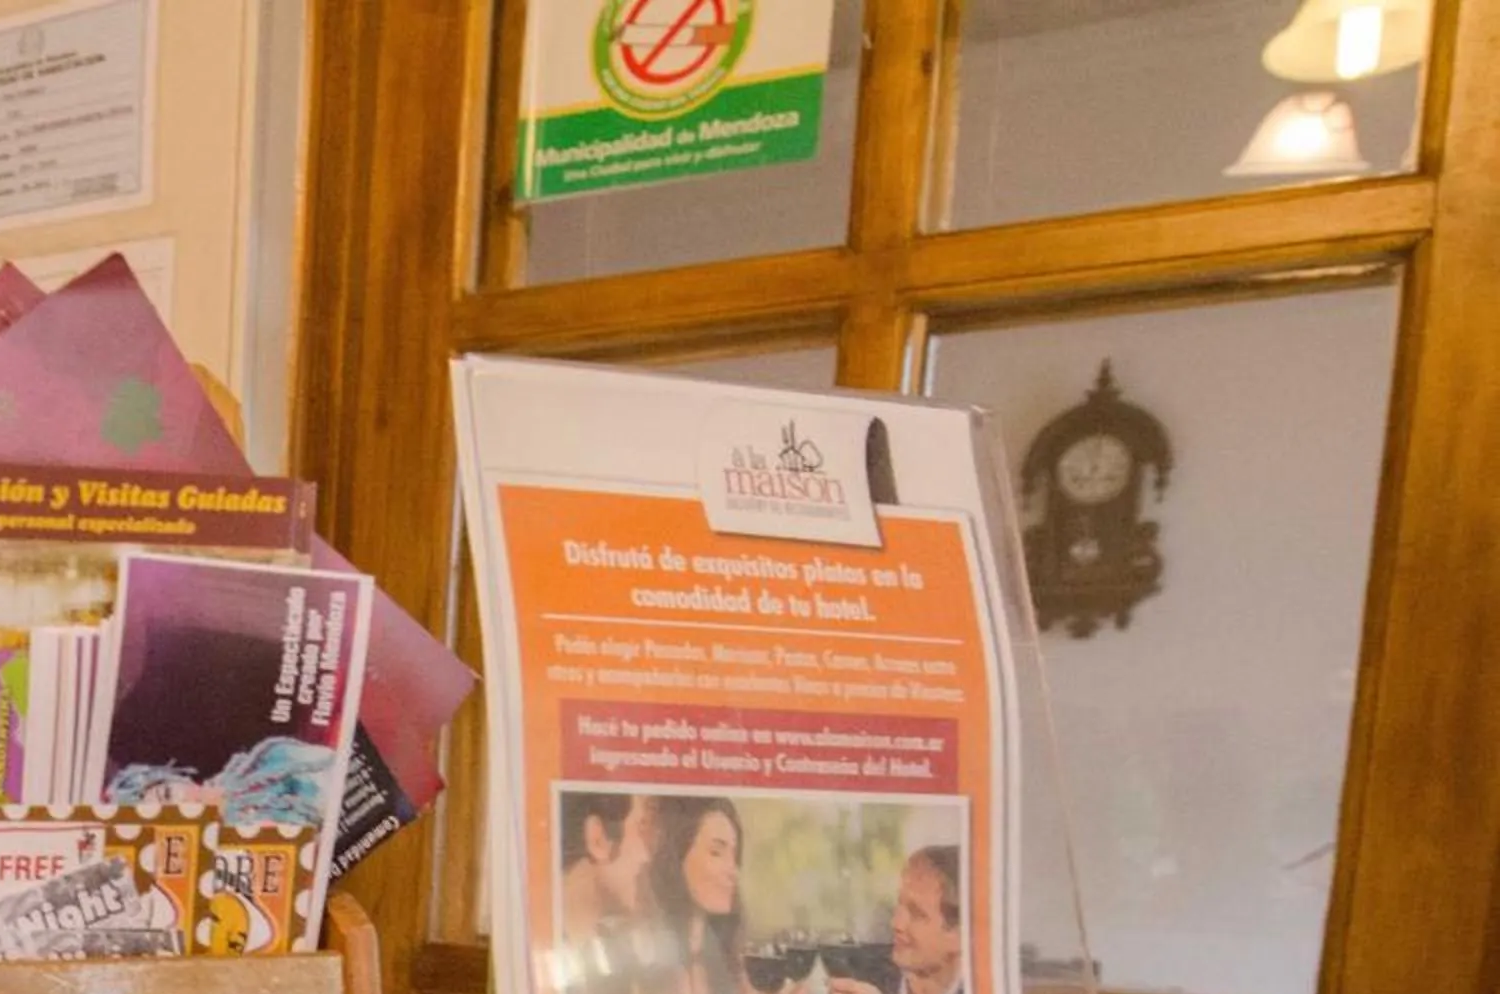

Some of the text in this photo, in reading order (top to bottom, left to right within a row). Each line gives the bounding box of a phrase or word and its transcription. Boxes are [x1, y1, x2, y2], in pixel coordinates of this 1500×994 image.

[534, 110, 799, 168] Municipalidad de Mendoza
[746, 444, 767, 469] la
[49, 486, 70, 509] y
[78, 479, 170, 508] Visitas
[178, 484, 288, 514] Guiadas
[723, 467, 846, 504] maison
[77, 516, 196, 534] especializado
[562, 539, 924, 590] Disfrutá de exquisitos platos en la
[630, 584, 877, 621] comodidad de tu hotel.
[297, 608, 324, 705] creado por
[310, 590, 346, 727] Flavio Mendoza
[270, 698, 293, 724] Un
[641, 718, 698, 745] pedido
[681, 747, 698, 769] el
[762, 758, 772, 777] y
[861, 754, 887, 777] del
[15, 878, 127, 932] Night
